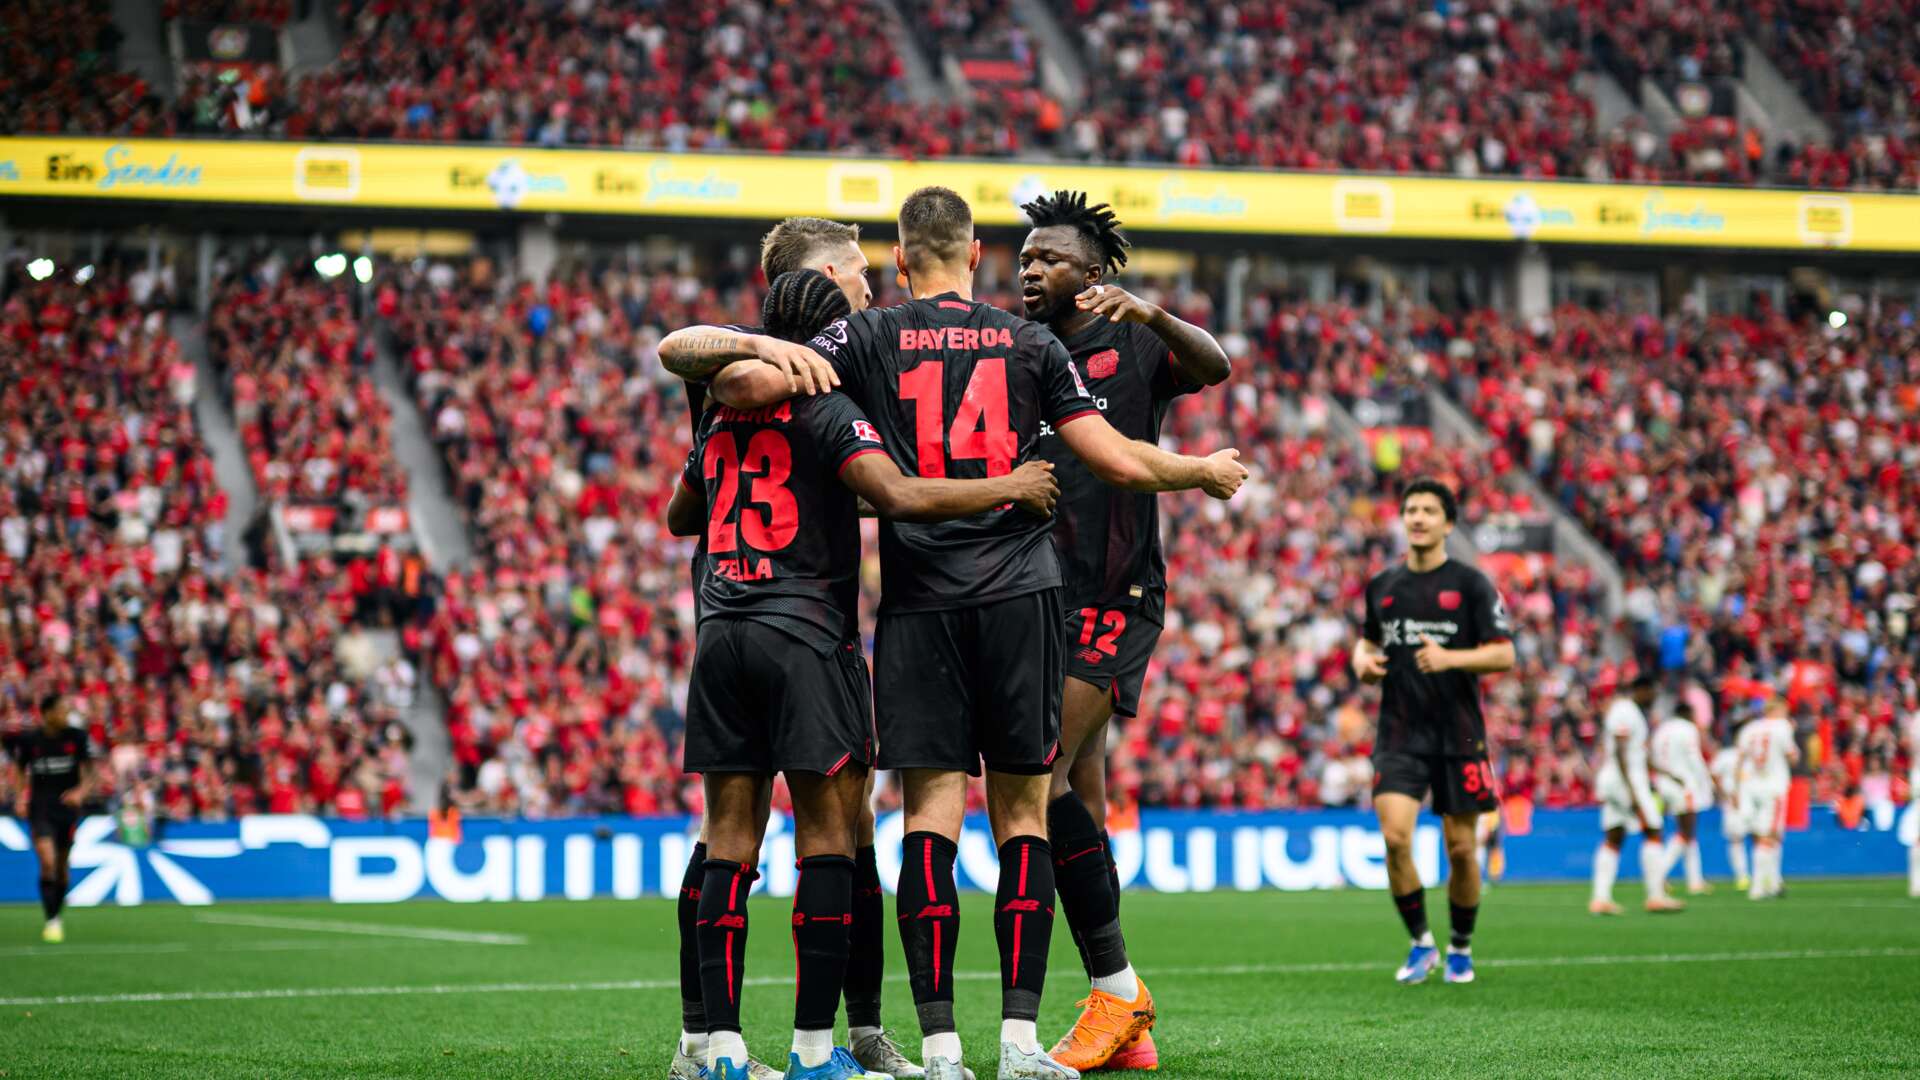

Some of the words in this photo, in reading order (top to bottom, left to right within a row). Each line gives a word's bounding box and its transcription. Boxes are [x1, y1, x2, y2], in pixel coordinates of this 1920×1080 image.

[46, 152, 95, 182] Ein
[810, 335, 839, 356] DAX
[898, 357, 1018, 479] 14
[703, 429, 799, 554] 23
[1079, 607, 1127, 657] 12
